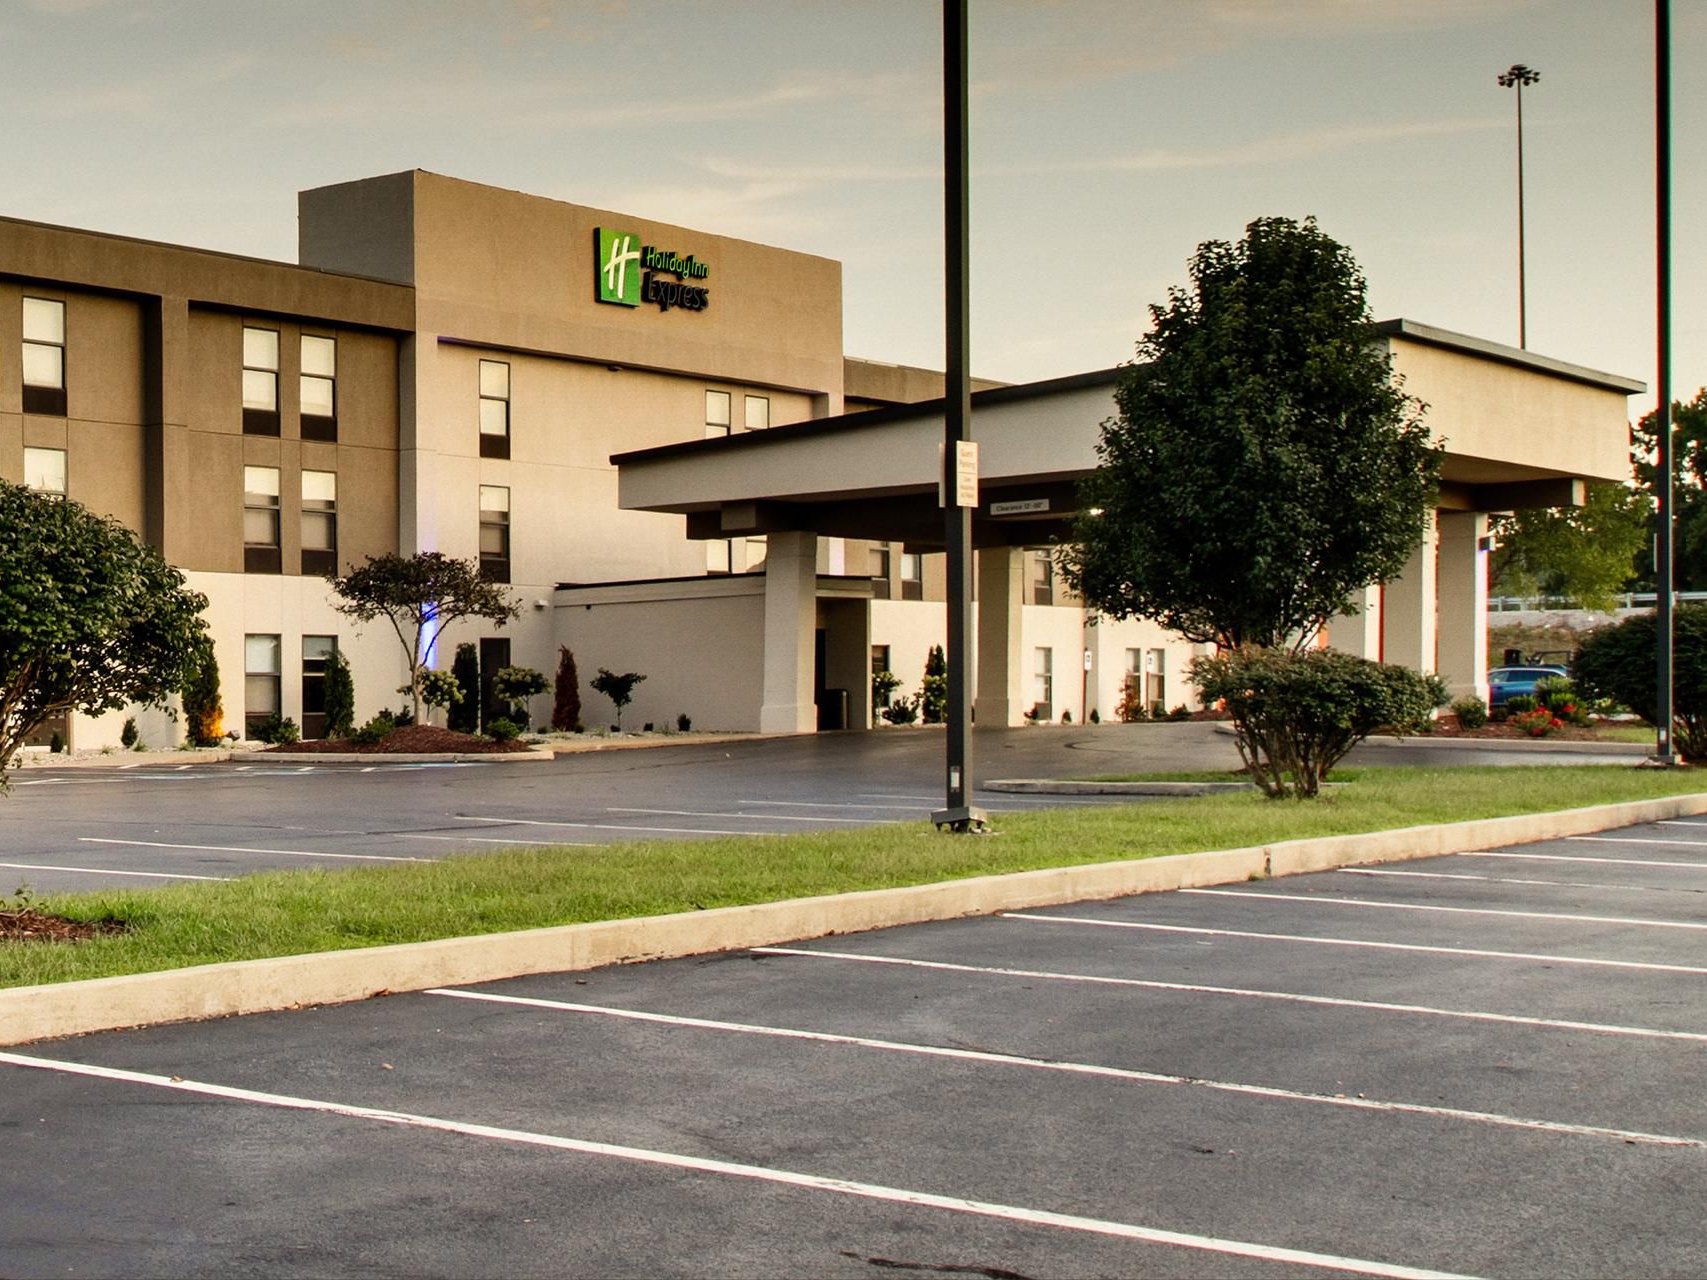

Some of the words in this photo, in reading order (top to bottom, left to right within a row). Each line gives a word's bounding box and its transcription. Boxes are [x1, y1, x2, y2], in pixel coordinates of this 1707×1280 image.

[646, 247, 690, 279] Holiday
[690, 256, 710, 278] Inn
[646, 272, 710, 311] Express
